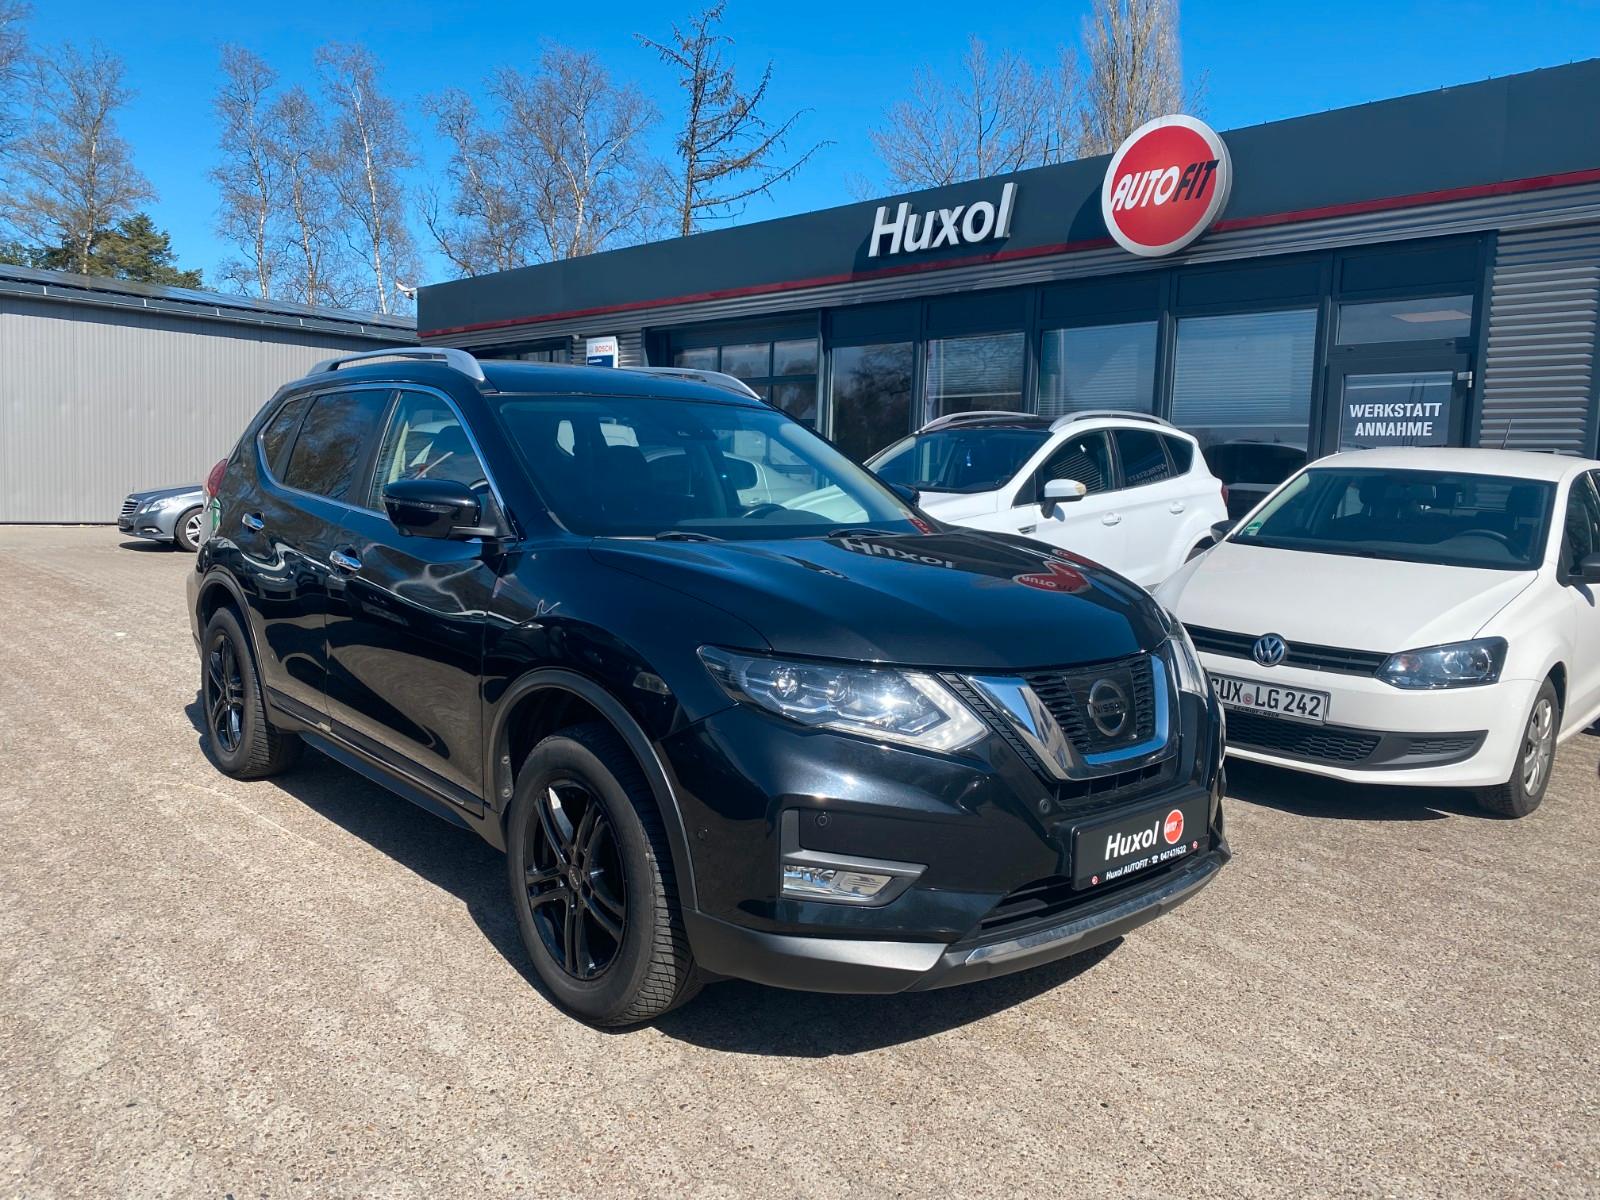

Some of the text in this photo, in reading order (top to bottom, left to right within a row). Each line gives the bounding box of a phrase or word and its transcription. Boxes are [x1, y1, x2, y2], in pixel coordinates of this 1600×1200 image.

[1112, 159, 1220, 212] AUTOFIT
[868, 182, 1017, 258] Huxol
[1349, 402, 1442, 418] WERKSTATT
[1354, 421, 1433, 436] ANNAHME
[1254, 686, 1280, 709] LG
[1283, 691, 1321, 717] 242
[1105, 821, 1160, 860] Huxol
[1105, 866, 1123, 880] Huxol
[1123, 858, 1149, 874] AUTOFIT
